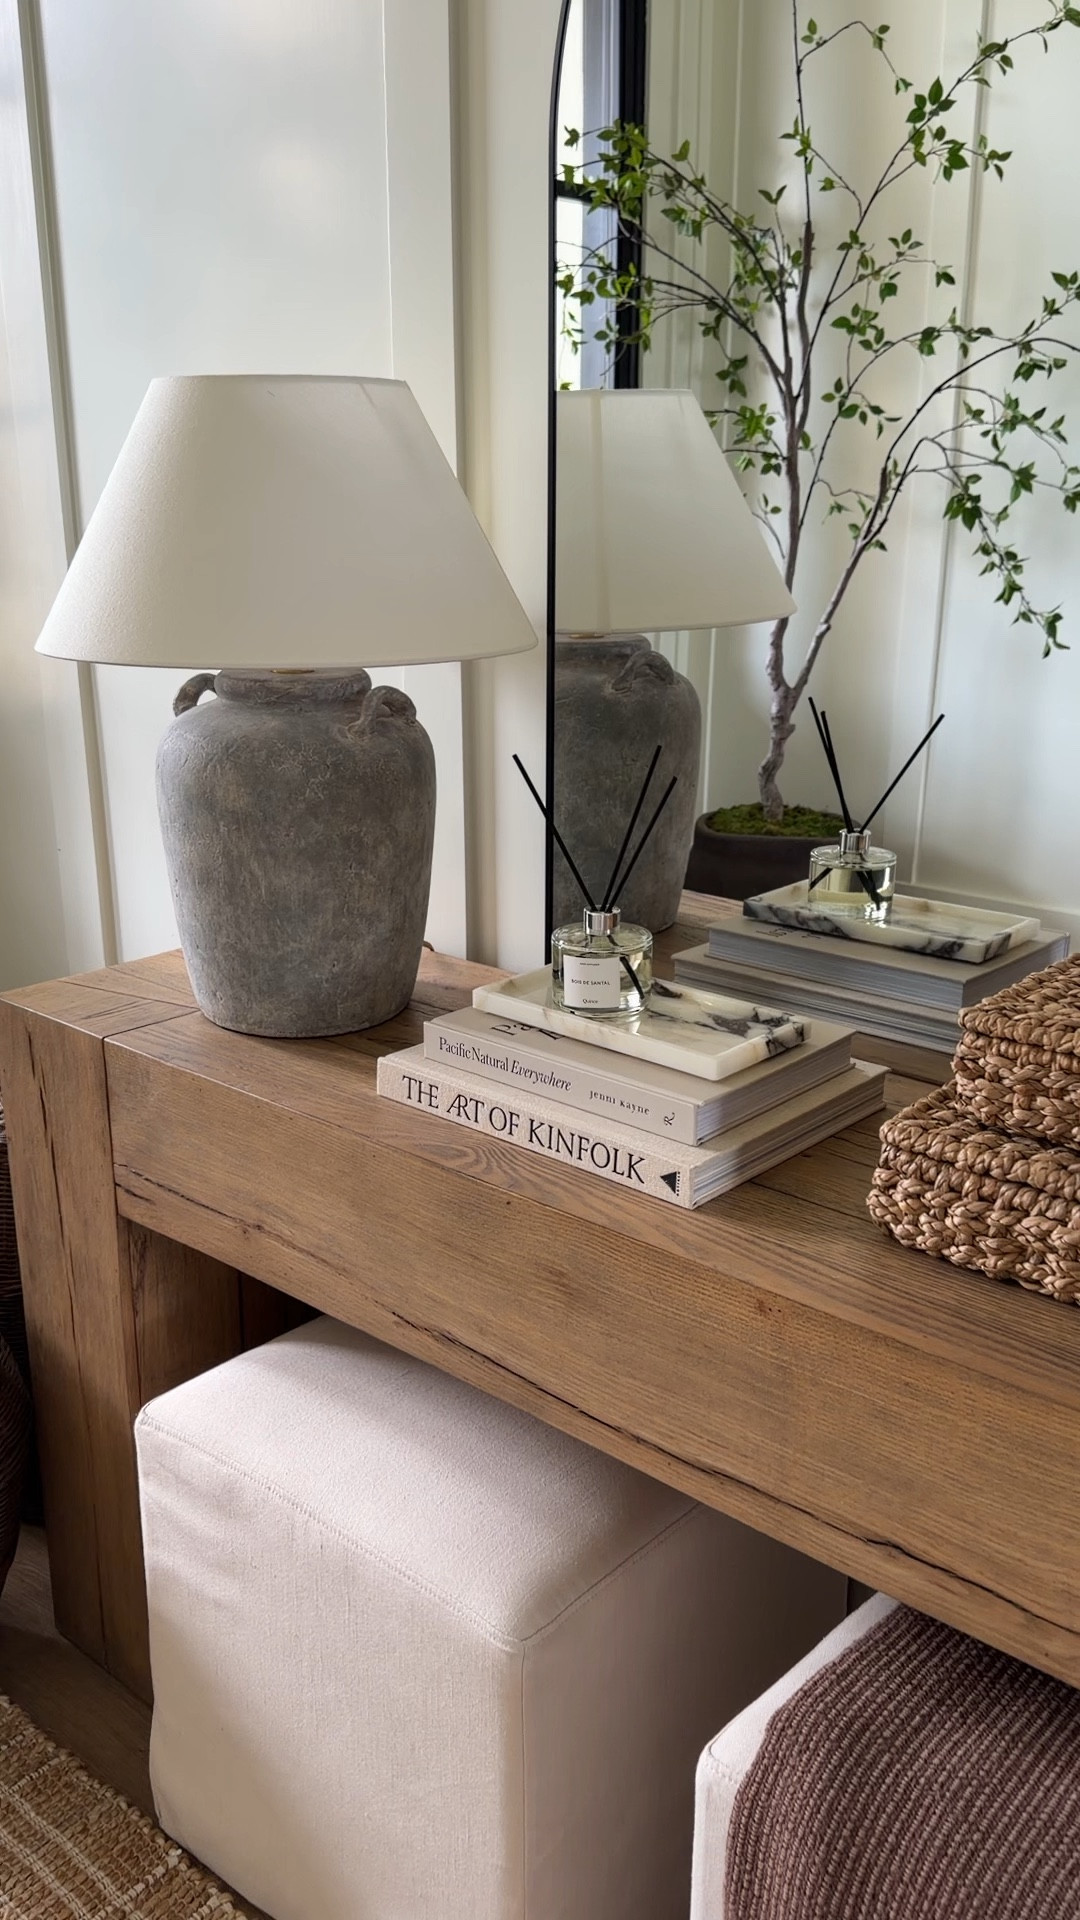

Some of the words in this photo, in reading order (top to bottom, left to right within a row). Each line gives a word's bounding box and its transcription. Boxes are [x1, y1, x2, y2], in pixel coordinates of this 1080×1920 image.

[439, 1036, 471, 1060] Pacific
[471, 1046, 509, 1072] Natural
[510, 1059, 572, 1091] Everywhere
[402, 1075, 439, 1109] THE
[446, 1094, 486, 1124] ART
[488, 1106, 521, 1138] OF
[528, 1118, 647, 1185] KINFOLK
